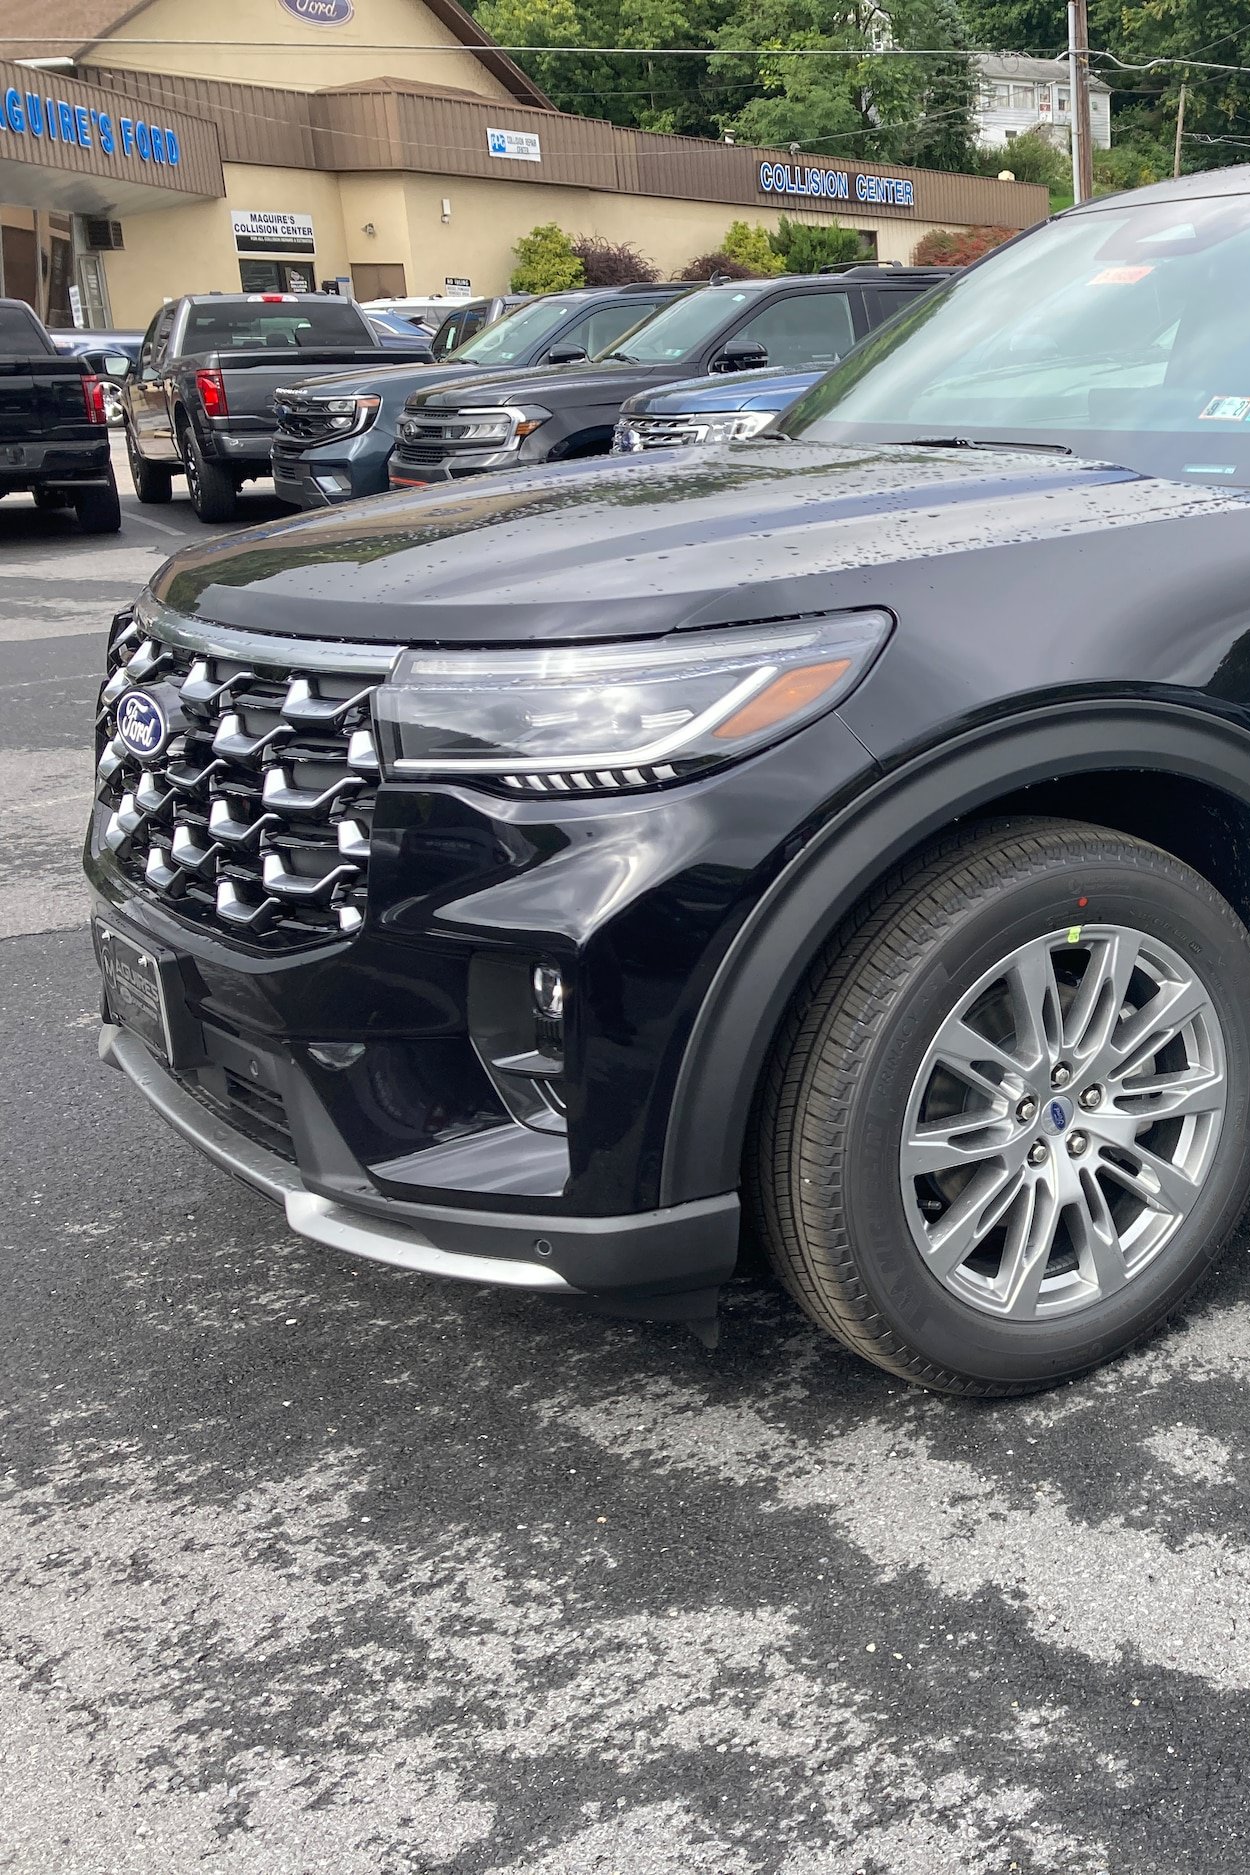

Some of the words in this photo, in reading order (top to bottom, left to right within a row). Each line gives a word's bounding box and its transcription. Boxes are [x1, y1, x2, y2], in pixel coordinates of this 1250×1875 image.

[120, 117, 180, 166] FORD
[760, 161, 849, 199] COLLISION
[855, 174, 914, 206] CENTER
[234, 223, 278, 235] COLLISION
[280, 226, 313, 236] CENTER
[249, 213, 295, 225] MAGUIRE'S
[1232, 400, 1250, 417] 27
[122, 697, 155, 748] Ford
